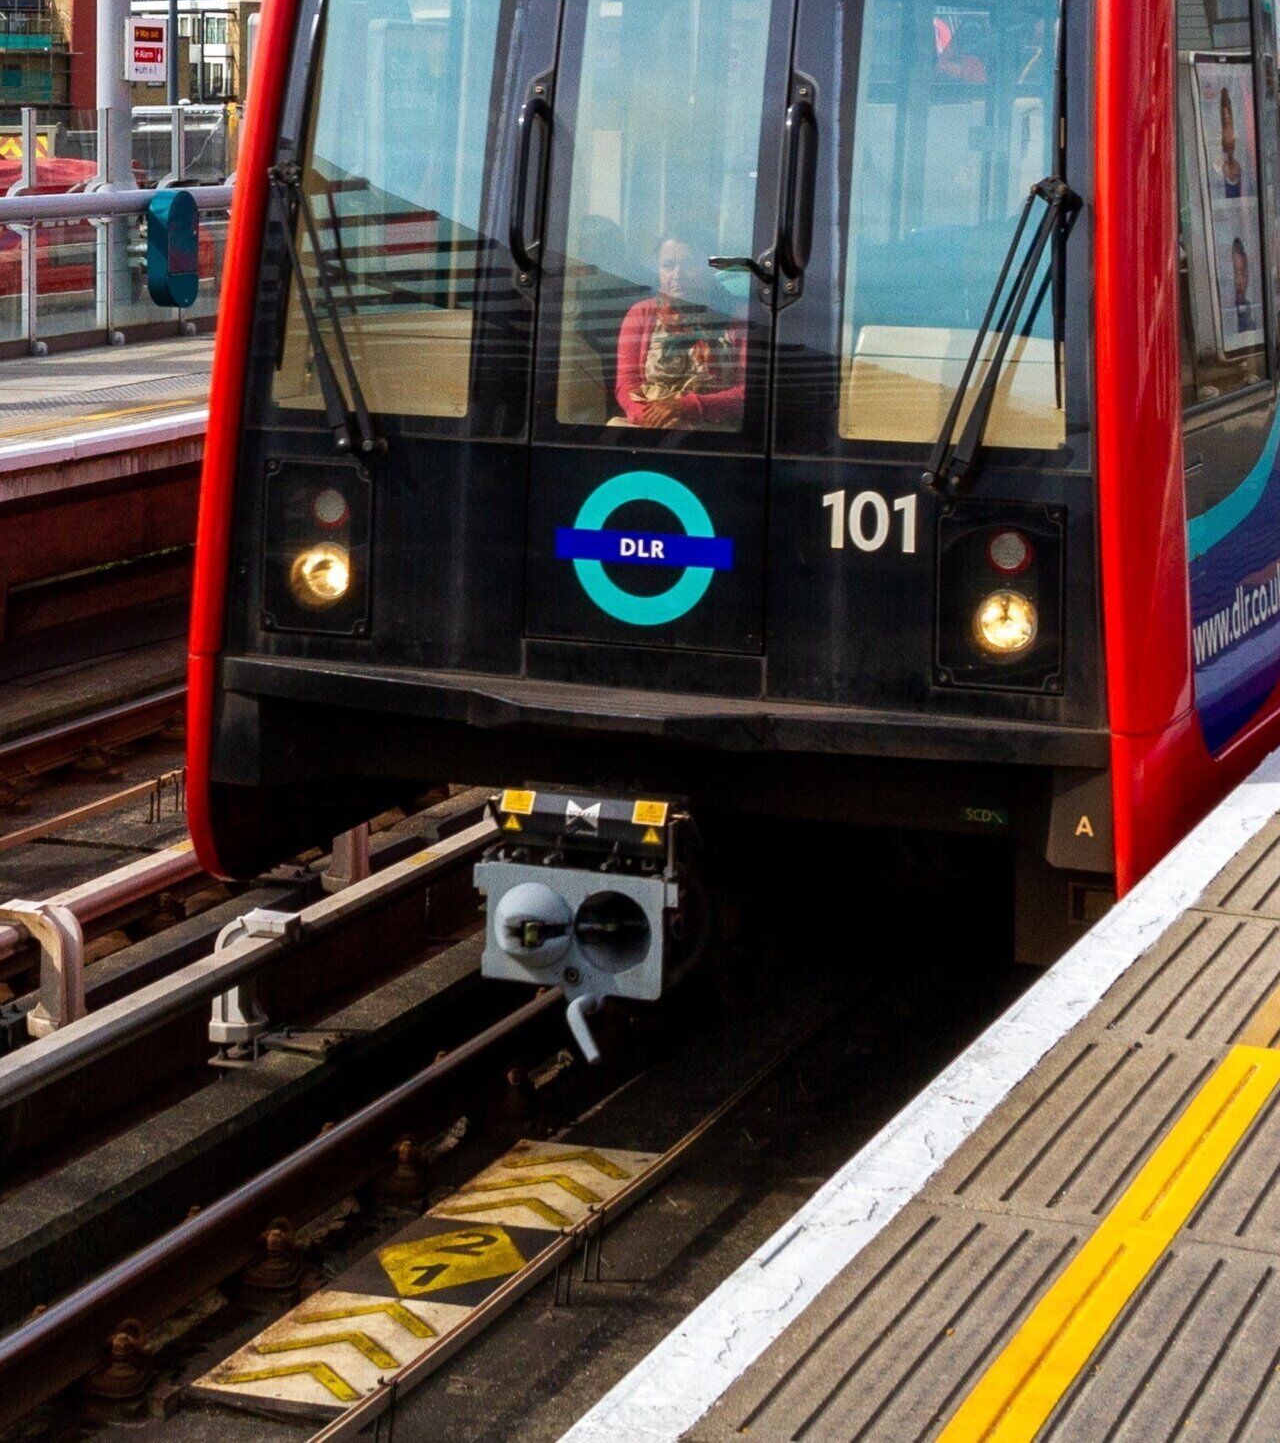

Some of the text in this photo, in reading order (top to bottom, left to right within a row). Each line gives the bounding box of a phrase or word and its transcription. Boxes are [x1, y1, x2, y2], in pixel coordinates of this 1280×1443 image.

[823, 489, 917, 554] 101
[620, 537, 665, 559] DLR
[1074, 815, 1095, 838] A
